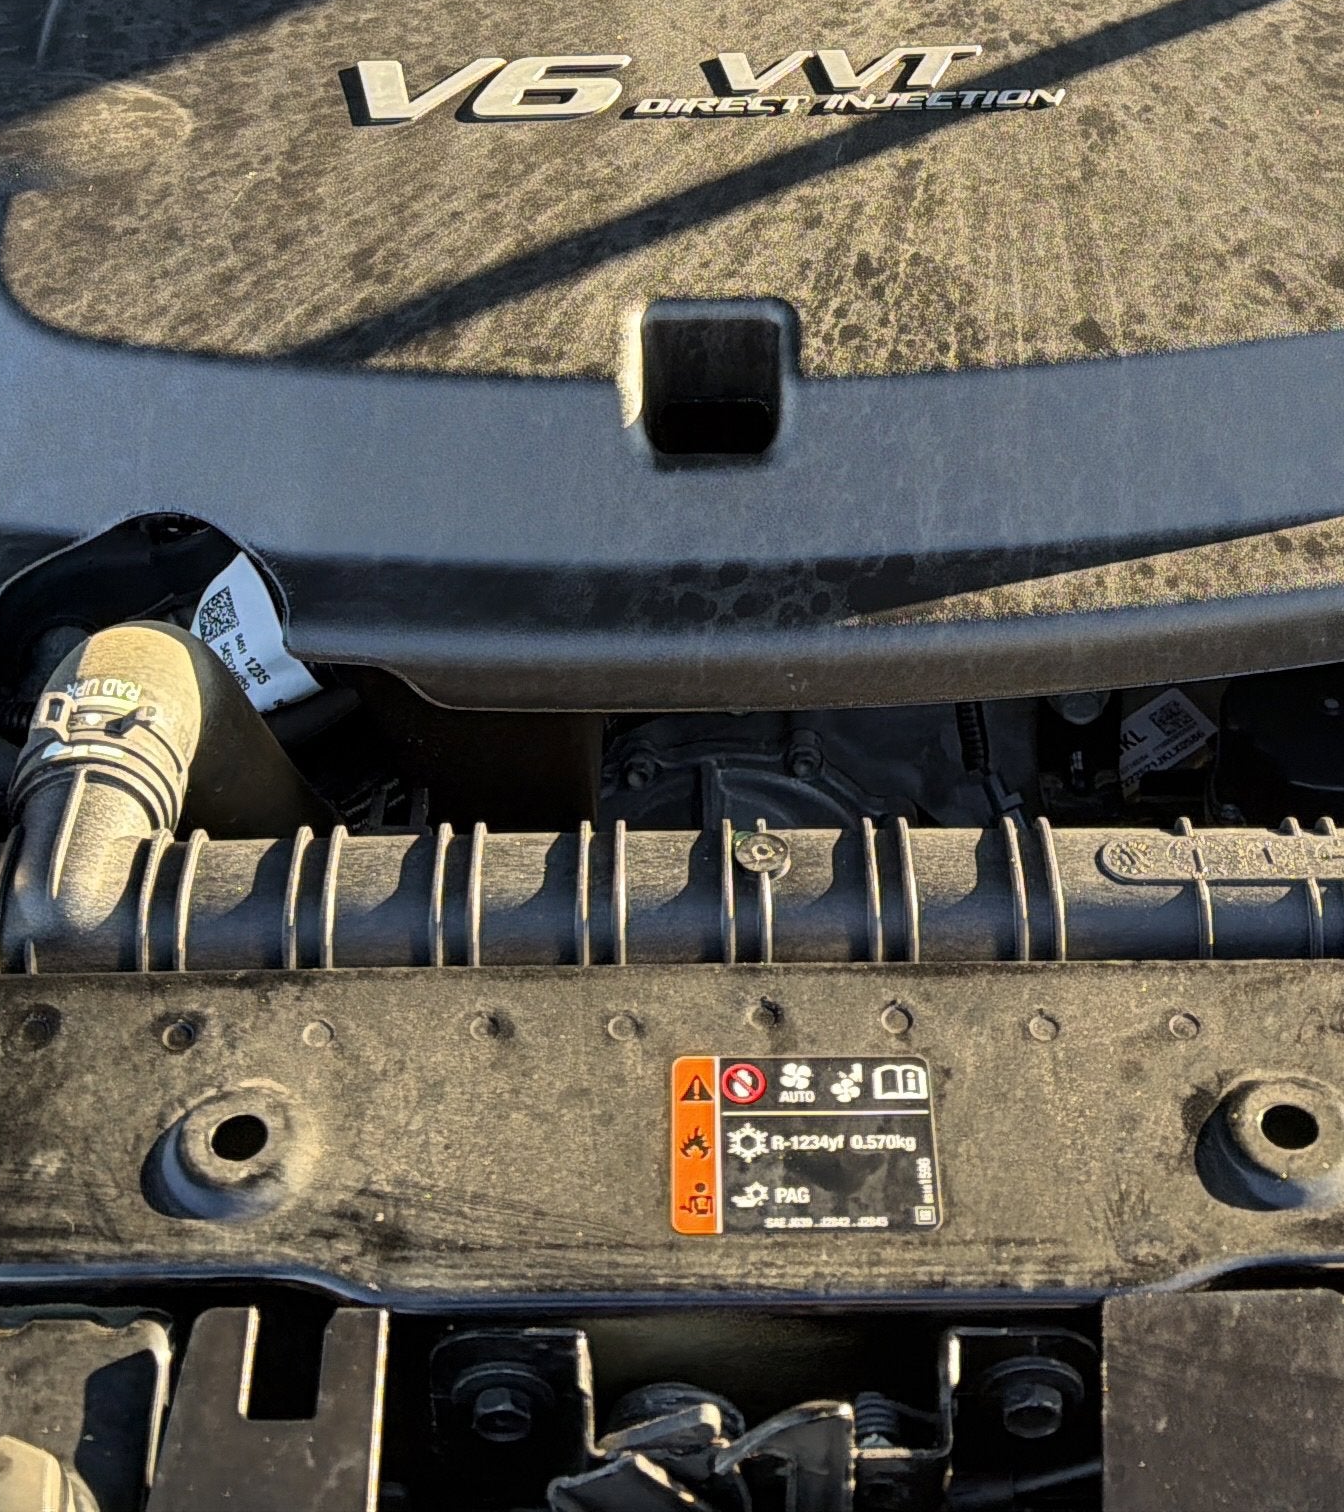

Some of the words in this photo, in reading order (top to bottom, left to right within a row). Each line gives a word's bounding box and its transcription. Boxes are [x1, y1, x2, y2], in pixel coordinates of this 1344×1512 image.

[716, 43, 984, 92] VVT
[354, 53, 633, 122] V6
[632, 93, 813, 117] DIRECT
[822, 87, 1066, 112] INJECTION
[244, 656, 272, 685] 1235
[102, 678, 143, 702] RAD
[778, 1090, 816, 1103] AUTO
[770, 1134, 845, 1152] R-1234yf
[849, 1134, 917, 1152] 0.570kg
[774, 1186, 811, 1204] PAG
